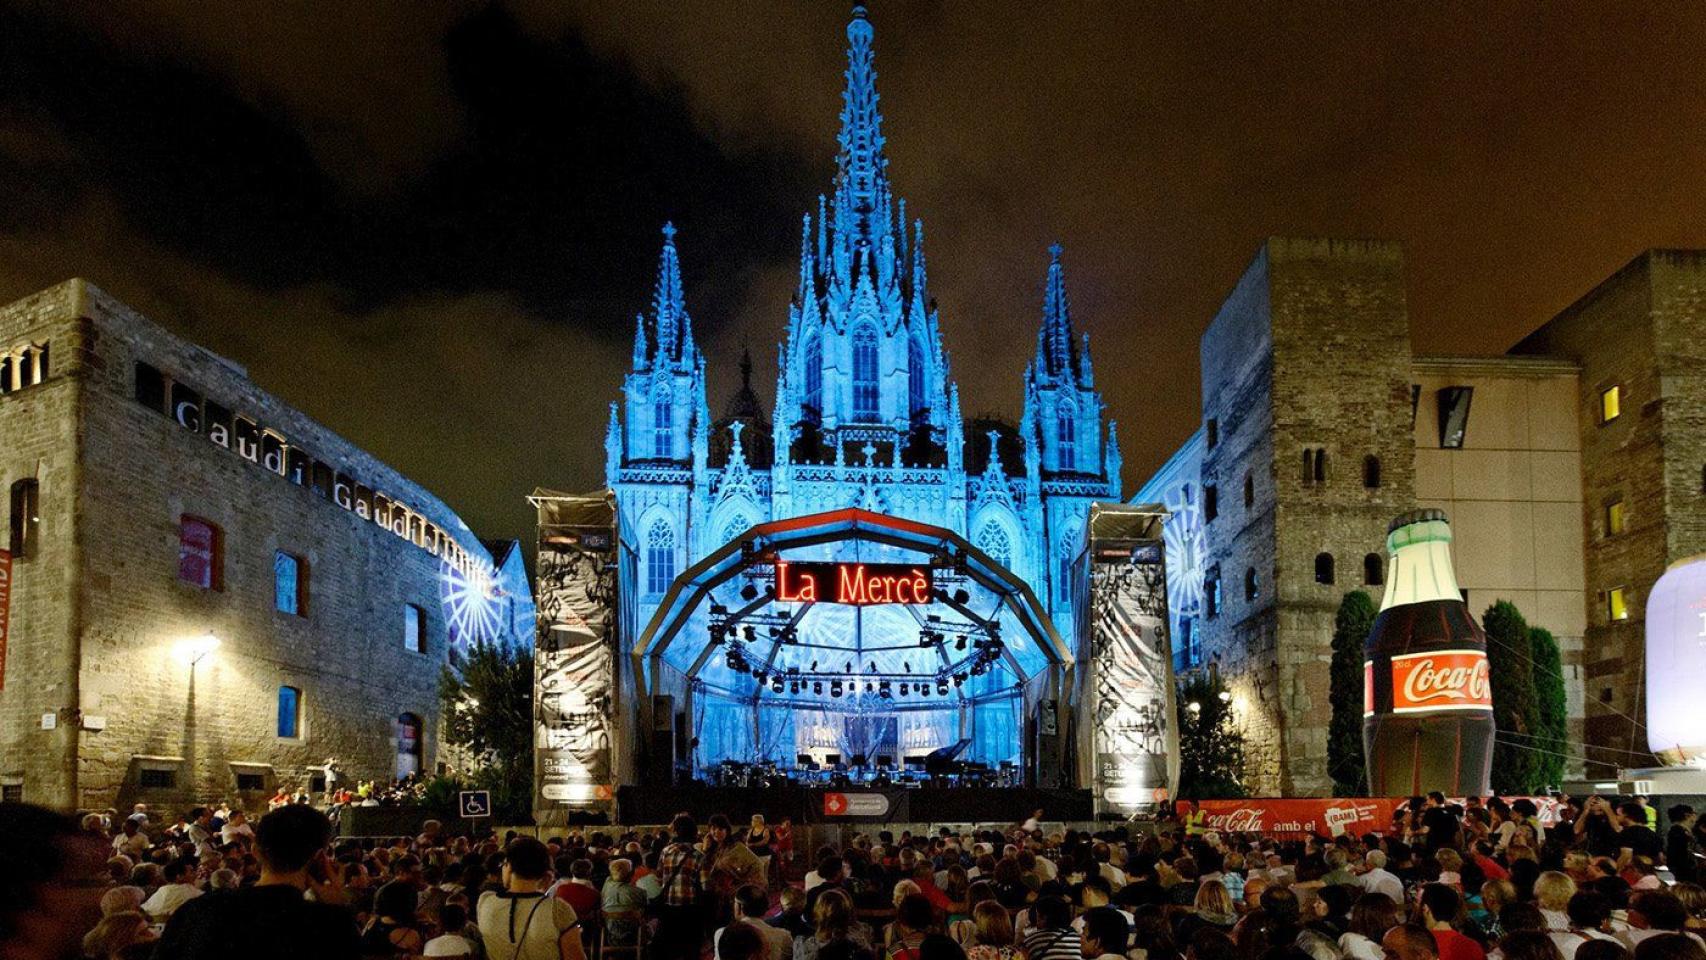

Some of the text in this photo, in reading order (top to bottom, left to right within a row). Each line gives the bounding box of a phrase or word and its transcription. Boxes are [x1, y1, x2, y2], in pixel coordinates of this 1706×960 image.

[778, 563, 928, 603] La Mercè
[1273, 820, 1301, 832] amb
[1304, 820, 1316, 832] el
